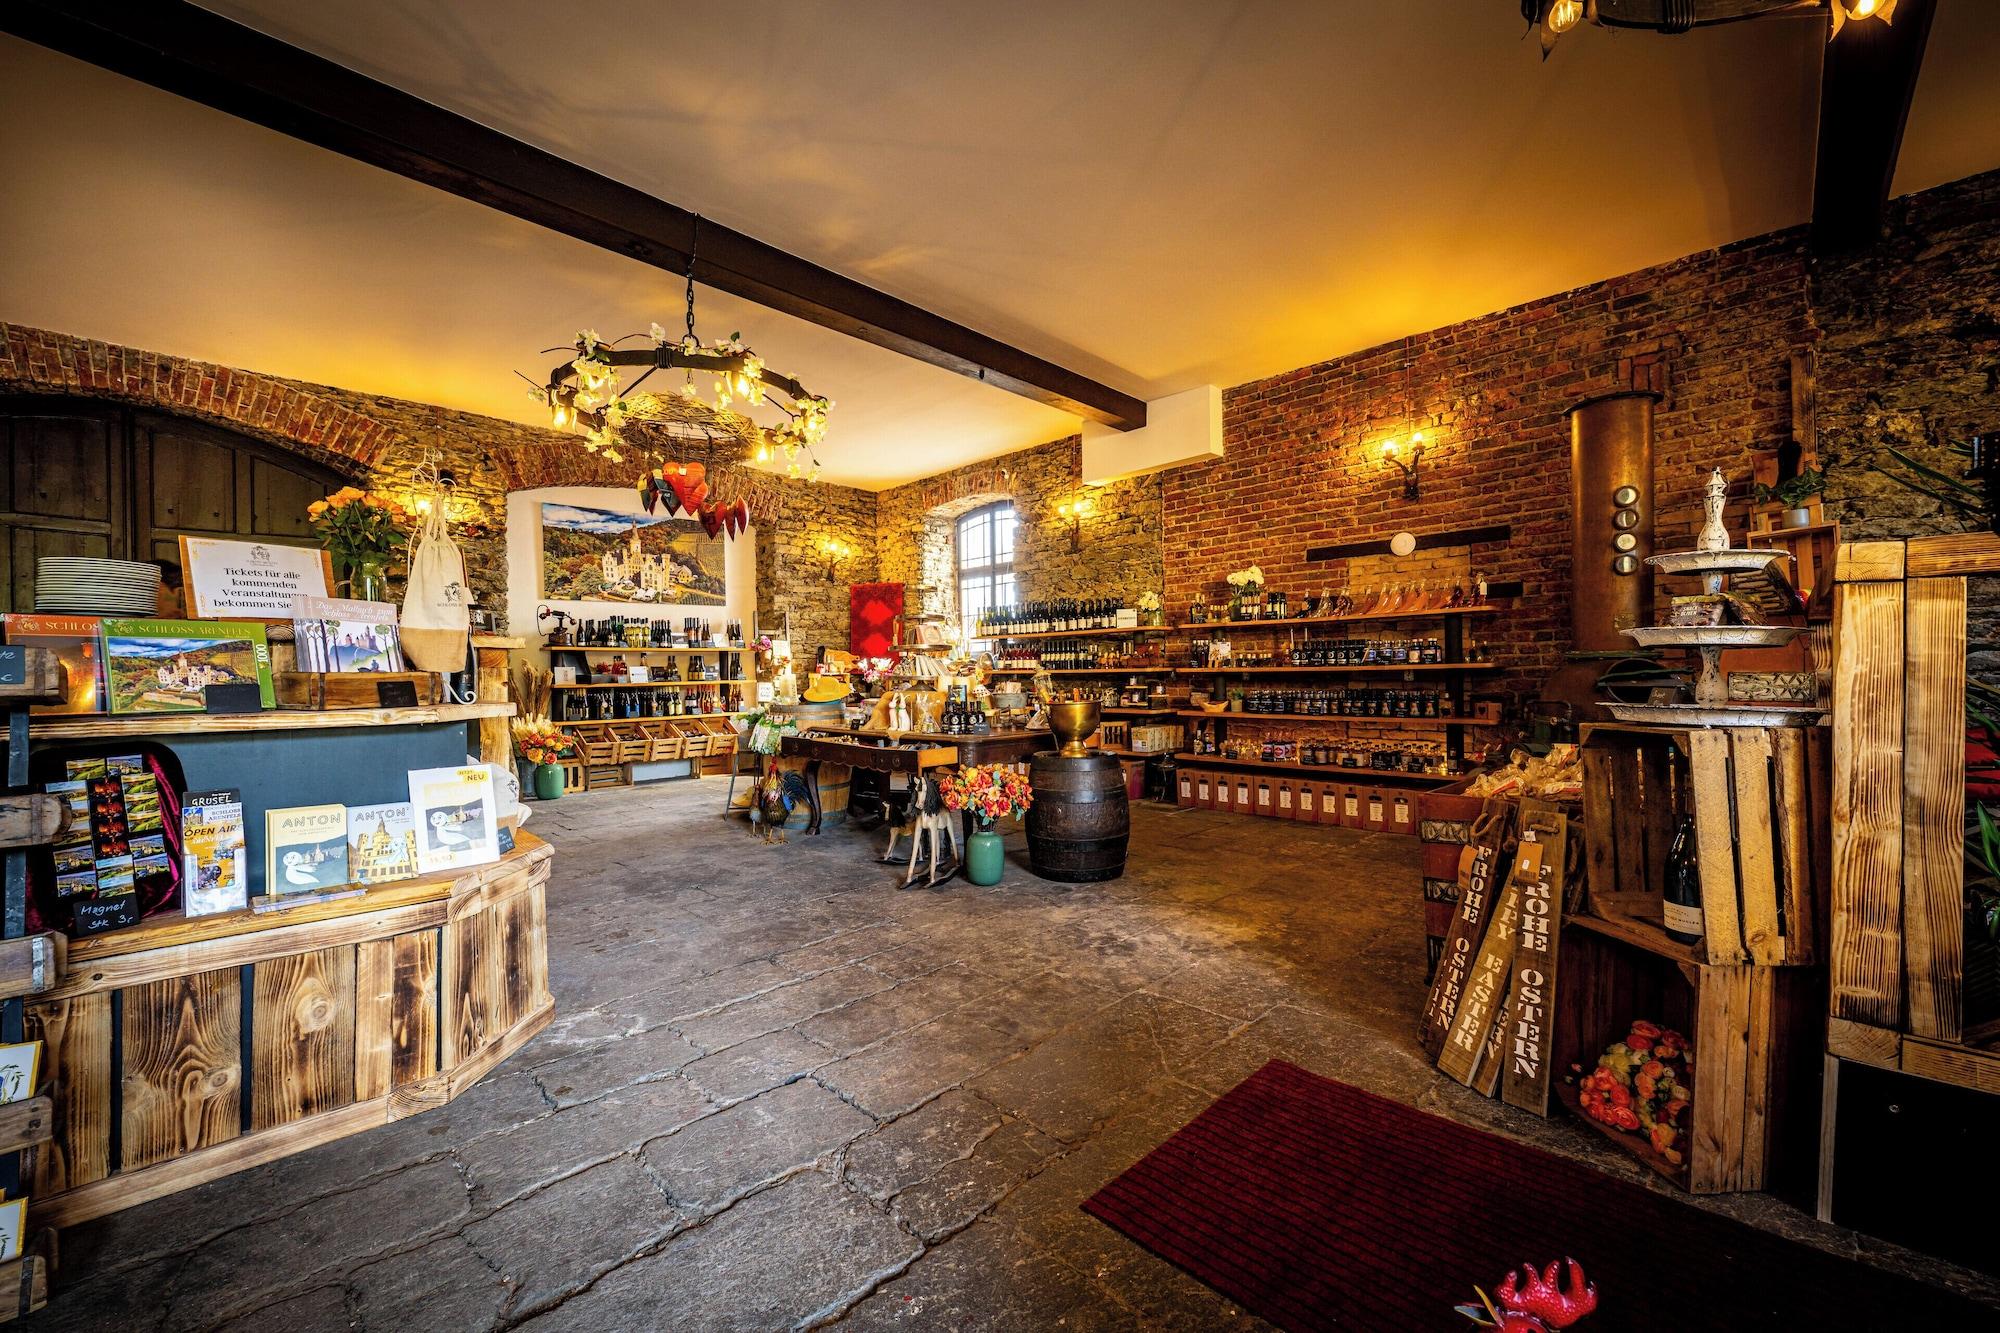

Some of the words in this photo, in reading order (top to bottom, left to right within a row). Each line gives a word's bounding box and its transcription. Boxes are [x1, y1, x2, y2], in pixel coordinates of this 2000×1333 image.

[223, 567, 263, 577] Tickets
[264, 568, 282, 578] für
[283, 570, 301, 580] alle
[231, 578, 297, 589] kommenden
[213, 598, 276, 609] bekommen
[277, 600, 292, 609] Sie
[45, 621, 98, 631] SCHLOS
[138, 625, 194, 634] SCHLOSS
[198, 626, 252, 635] ARENFELS
[255, 644, 269, 663] 1000
[467, 774, 485, 782] NEU
[191, 795, 233, 806] GRUSEL
[282, 812, 342, 829] ANTON
[354, 807, 406, 822] ANTON
[184, 828, 216, 837] OPEN
[1461, 845, 1493, 924] FROHE
[80, 900, 126, 916] Magnet
[1436, 937, 1470, 1031] OSTERN
[1453, 953, 1503, 1052] EASTER
[1513, 968, 1544, 1079] OSTERN
